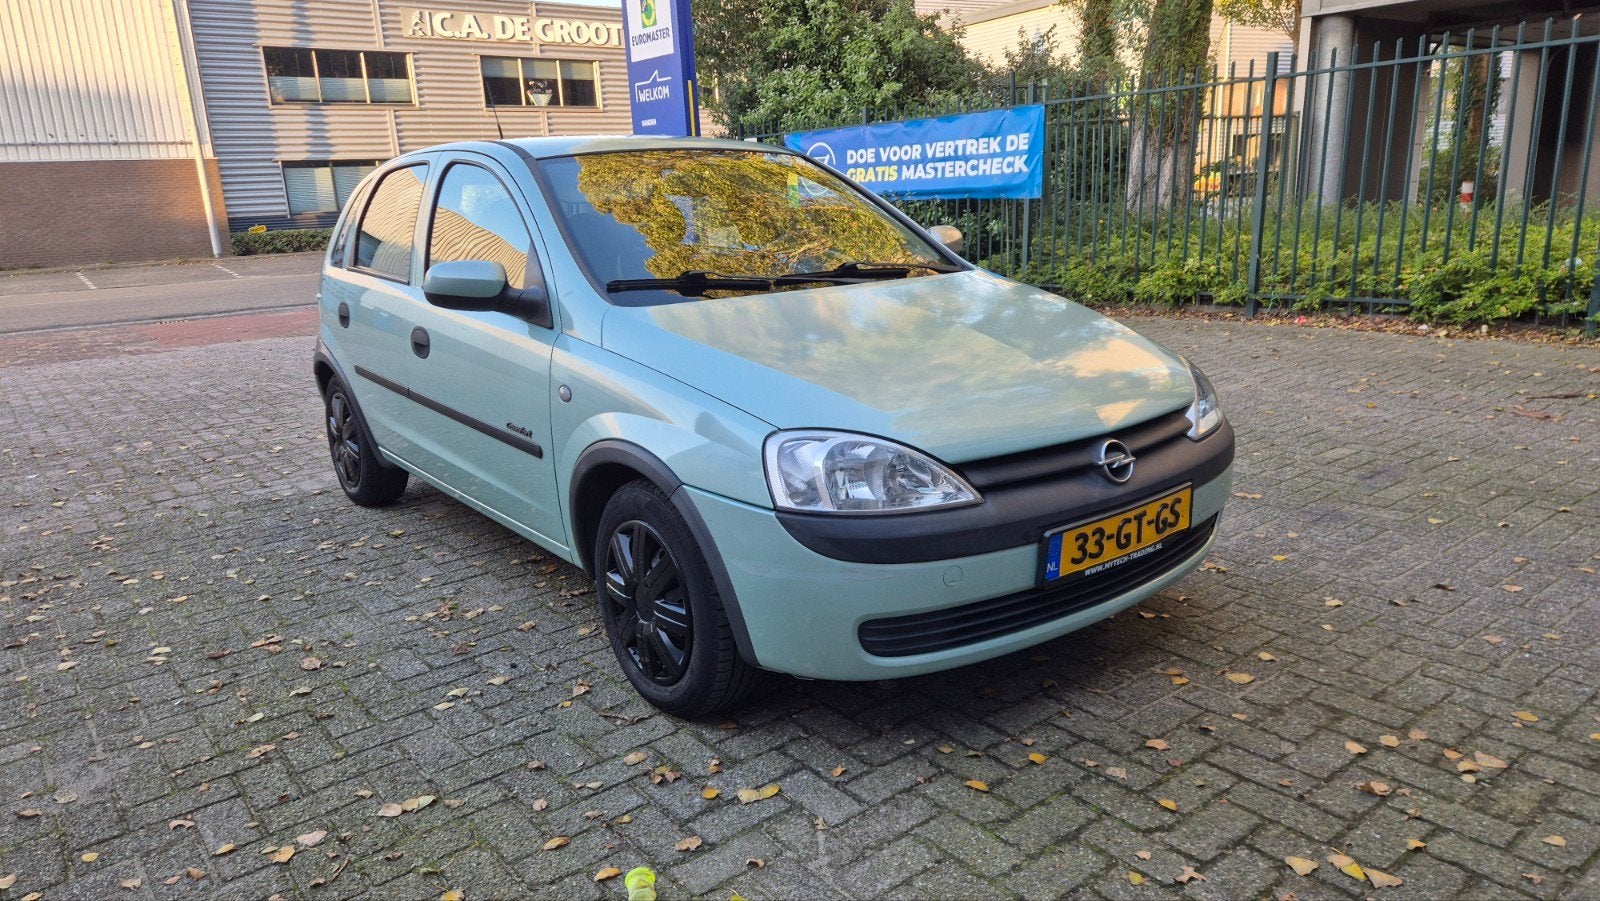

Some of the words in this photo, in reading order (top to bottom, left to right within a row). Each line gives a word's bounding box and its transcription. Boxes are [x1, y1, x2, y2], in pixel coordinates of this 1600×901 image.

[432, 12, 489, 39] C.A.
[493, 15, 532, 41] DE
[534, 18, 624, 46] GROOT
[631, 26, 671, 47] EUROMASTER
[638, 85, 670, 102] WELKOM
[846, 147, 876, 165] DOE
[879, 143, 921, 162] VOOR
[924, 136, 1002, 159] VERTREK
[1005, 133, 1030, 152] DE
[846, 165, 898, 183] GRATIS
[901, 155, 1029, 181] MASTERCHECK
[1070, 497, 1182, 565] 33-GT-GS
[1046, 561, 1058, 573] NL
[1084, 542, 1163, 576] WWW.MYTECH-TRADING.NL
